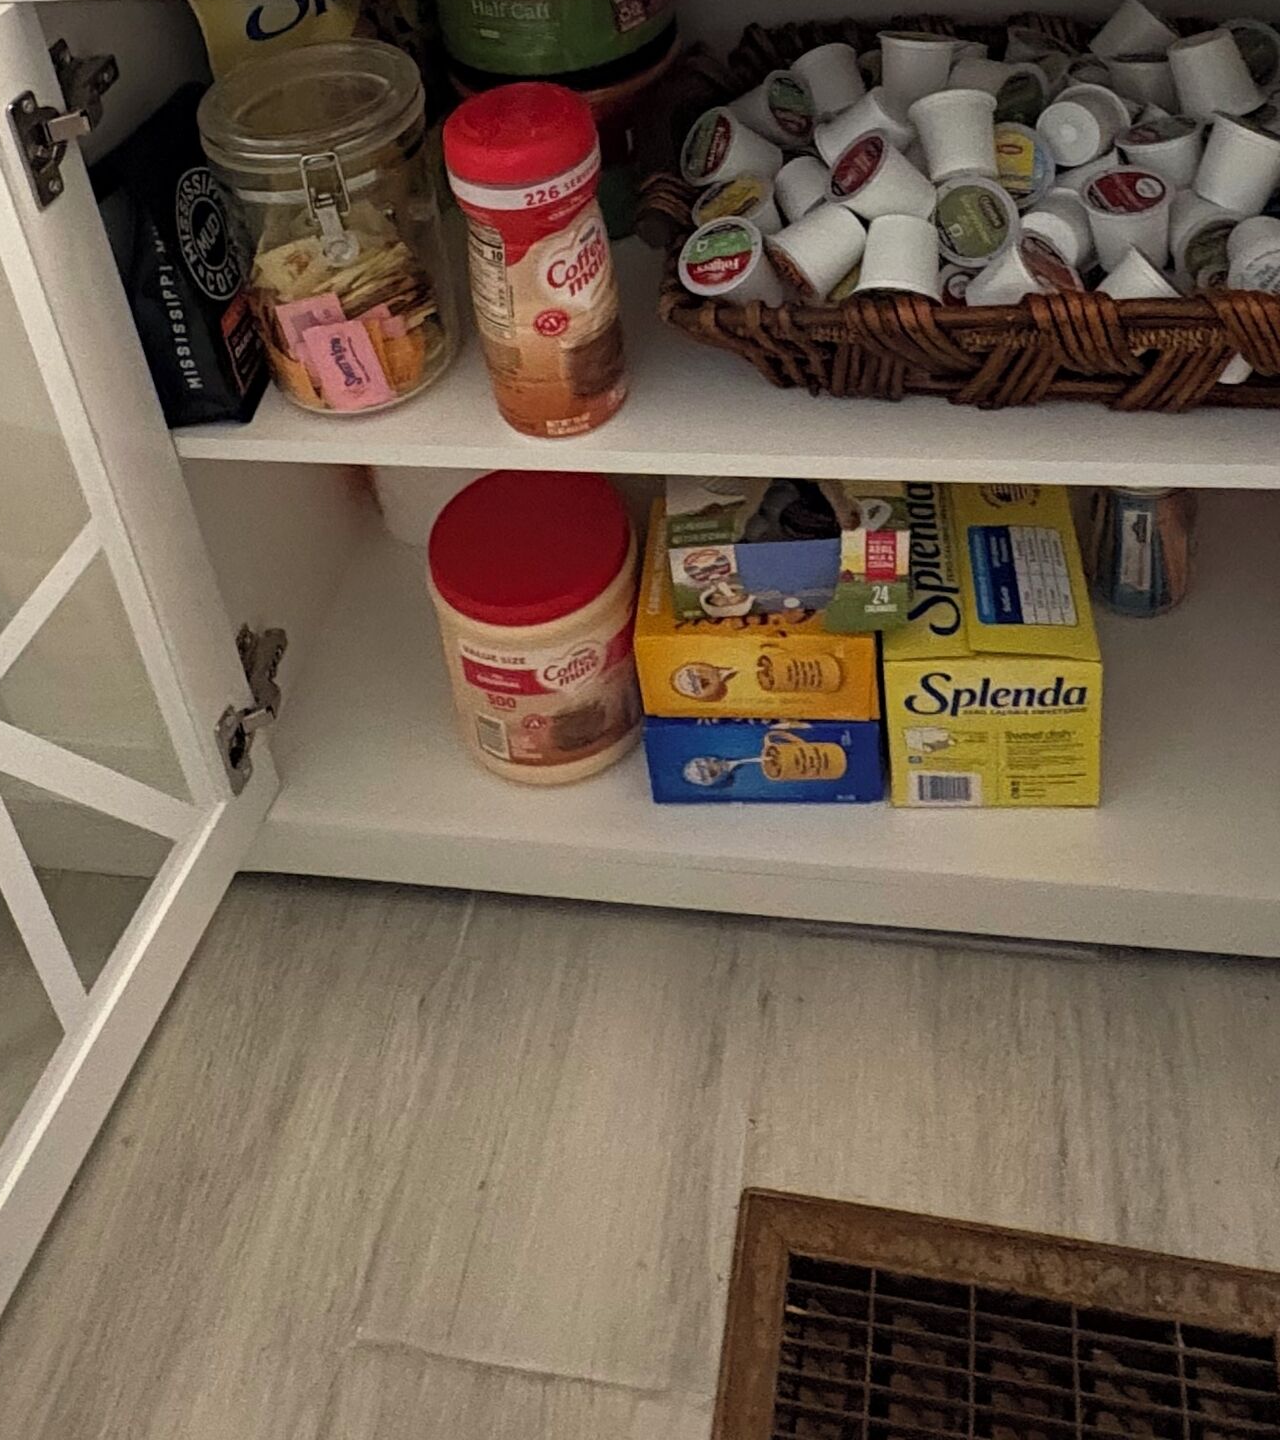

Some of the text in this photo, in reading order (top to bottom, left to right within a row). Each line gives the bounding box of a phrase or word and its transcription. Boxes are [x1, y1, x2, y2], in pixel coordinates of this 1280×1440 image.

[523, 186, 561, 207] 226
[196, 212, 221, 258] MUD
[159, 265, 204, 389] MISSISSIPPI
[907, 482, 961, 636] Splenda
[871, 585, 889, 605] 24
[904, 672, 1089, 717] Splenda
